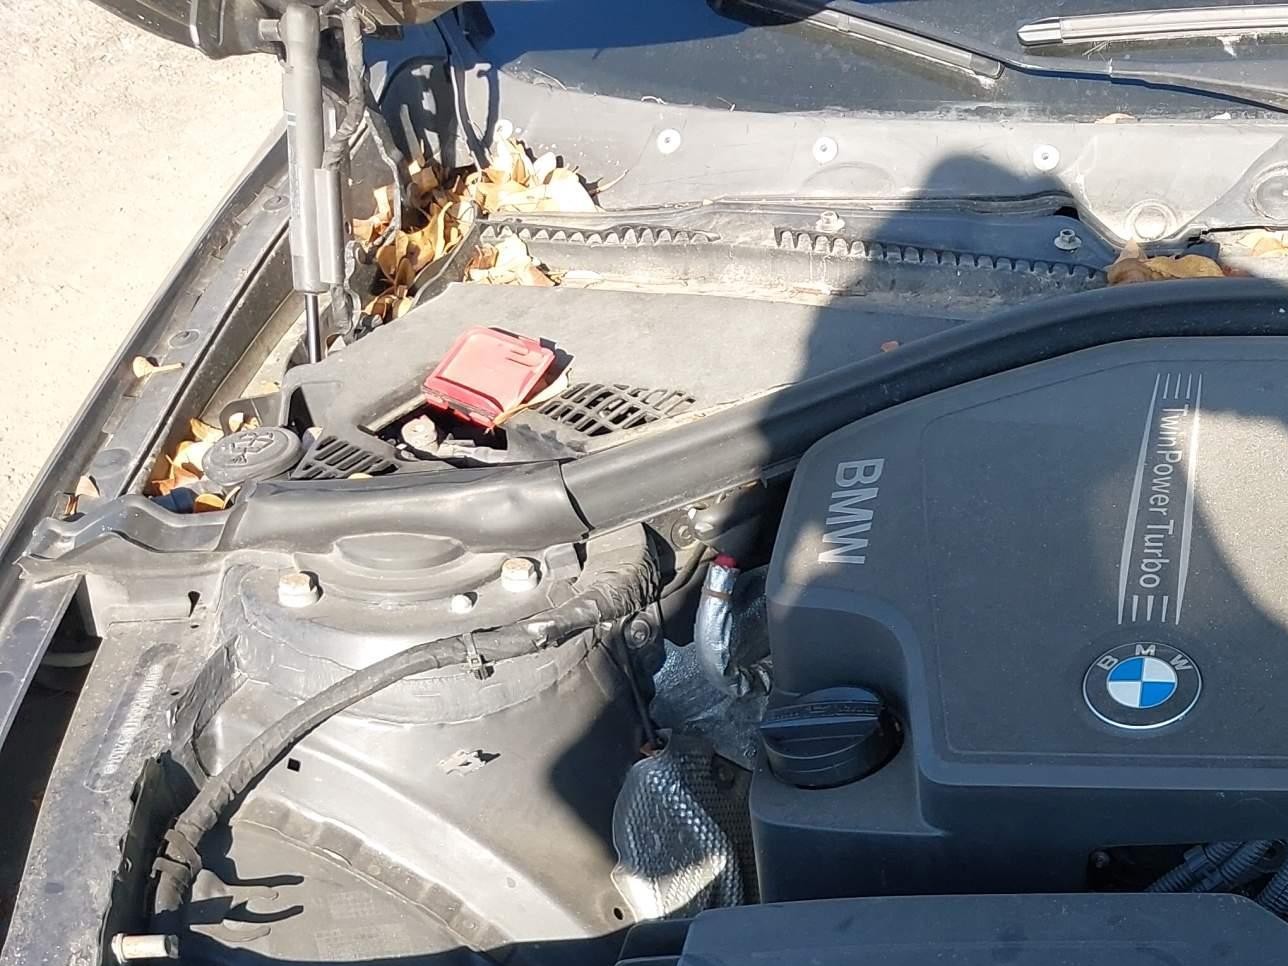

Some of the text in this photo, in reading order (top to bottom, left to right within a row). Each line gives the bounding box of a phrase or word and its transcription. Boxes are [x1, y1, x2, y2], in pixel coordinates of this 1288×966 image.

[817, 458, 885, 564] BMW
[1139, 404, 1189, 588] TwinPower Turbo
[1096, 643, 1193, 671] BMW
